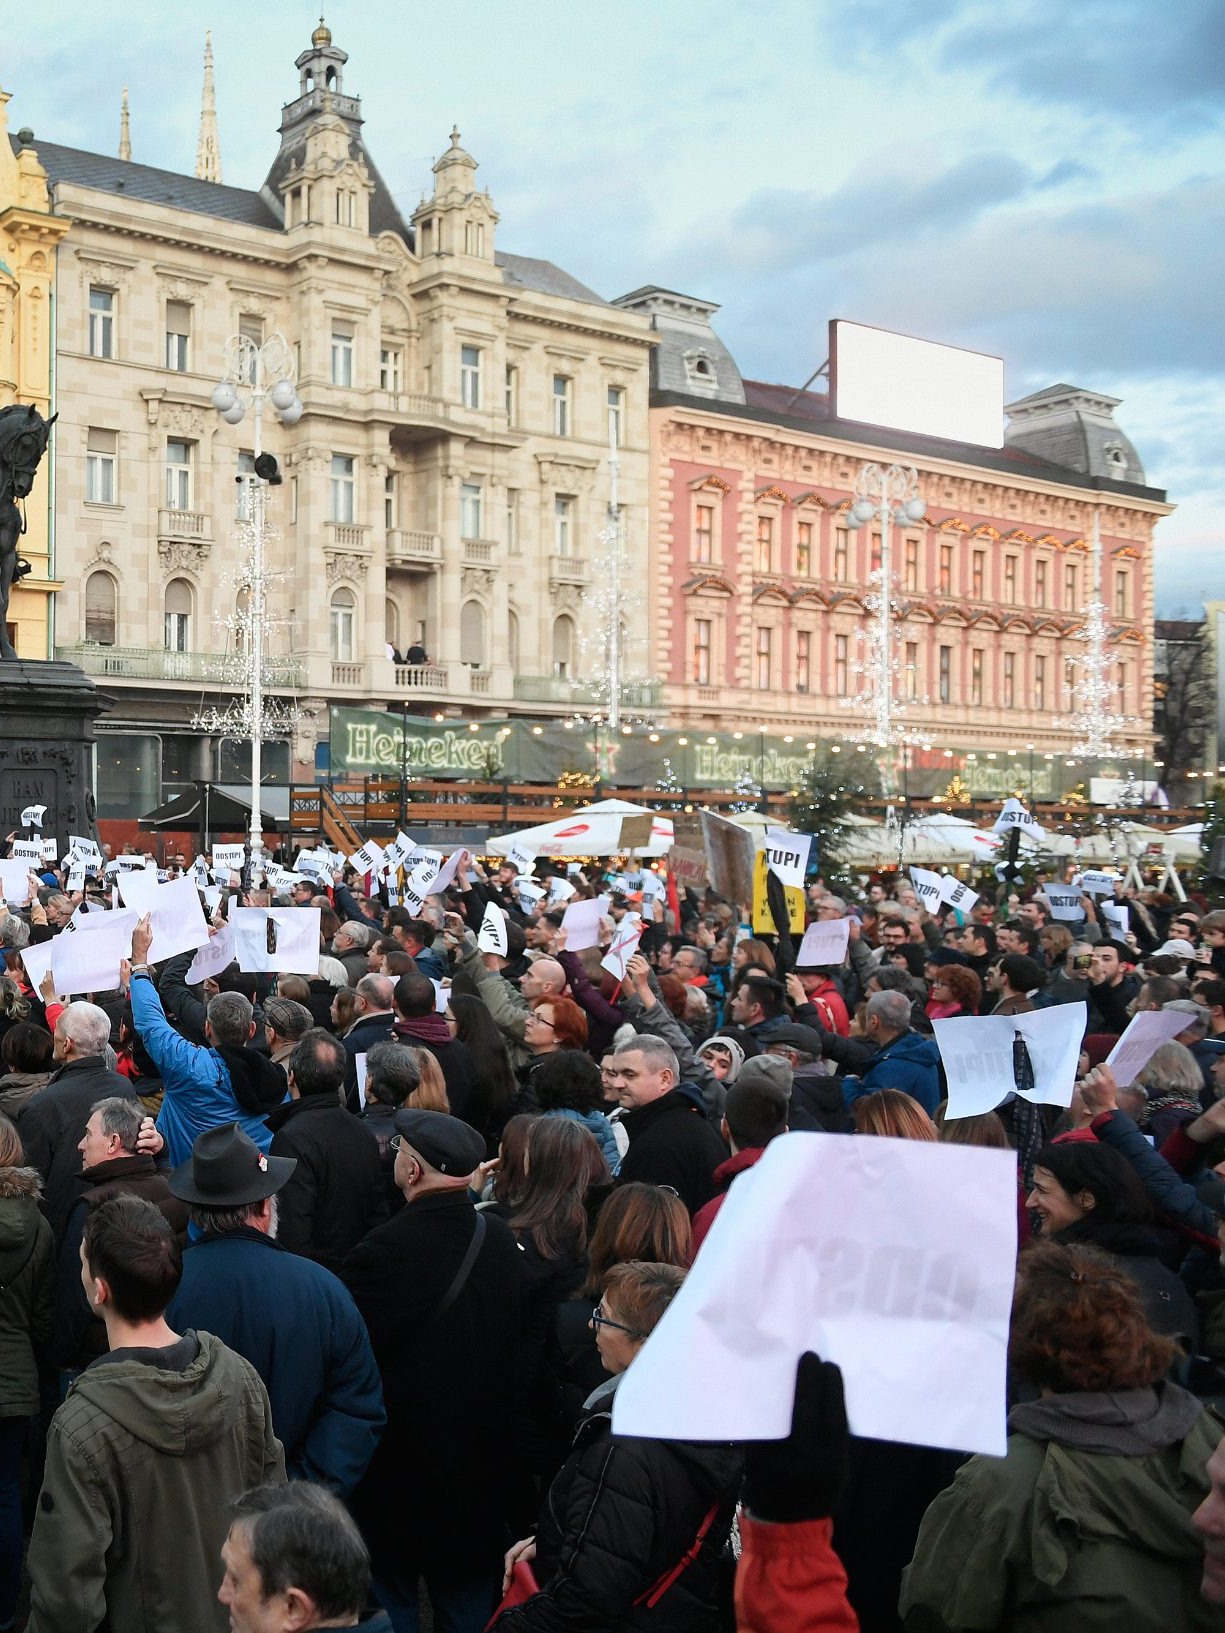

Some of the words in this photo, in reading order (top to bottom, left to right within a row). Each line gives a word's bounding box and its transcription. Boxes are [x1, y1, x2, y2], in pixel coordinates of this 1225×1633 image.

[345, 722, 505, 769] Heineken
[14, 848, 40, 857] ODSTUPI
[357, 847, 374, 866] TUPI
[765, 847, 801, 869] TUPI
